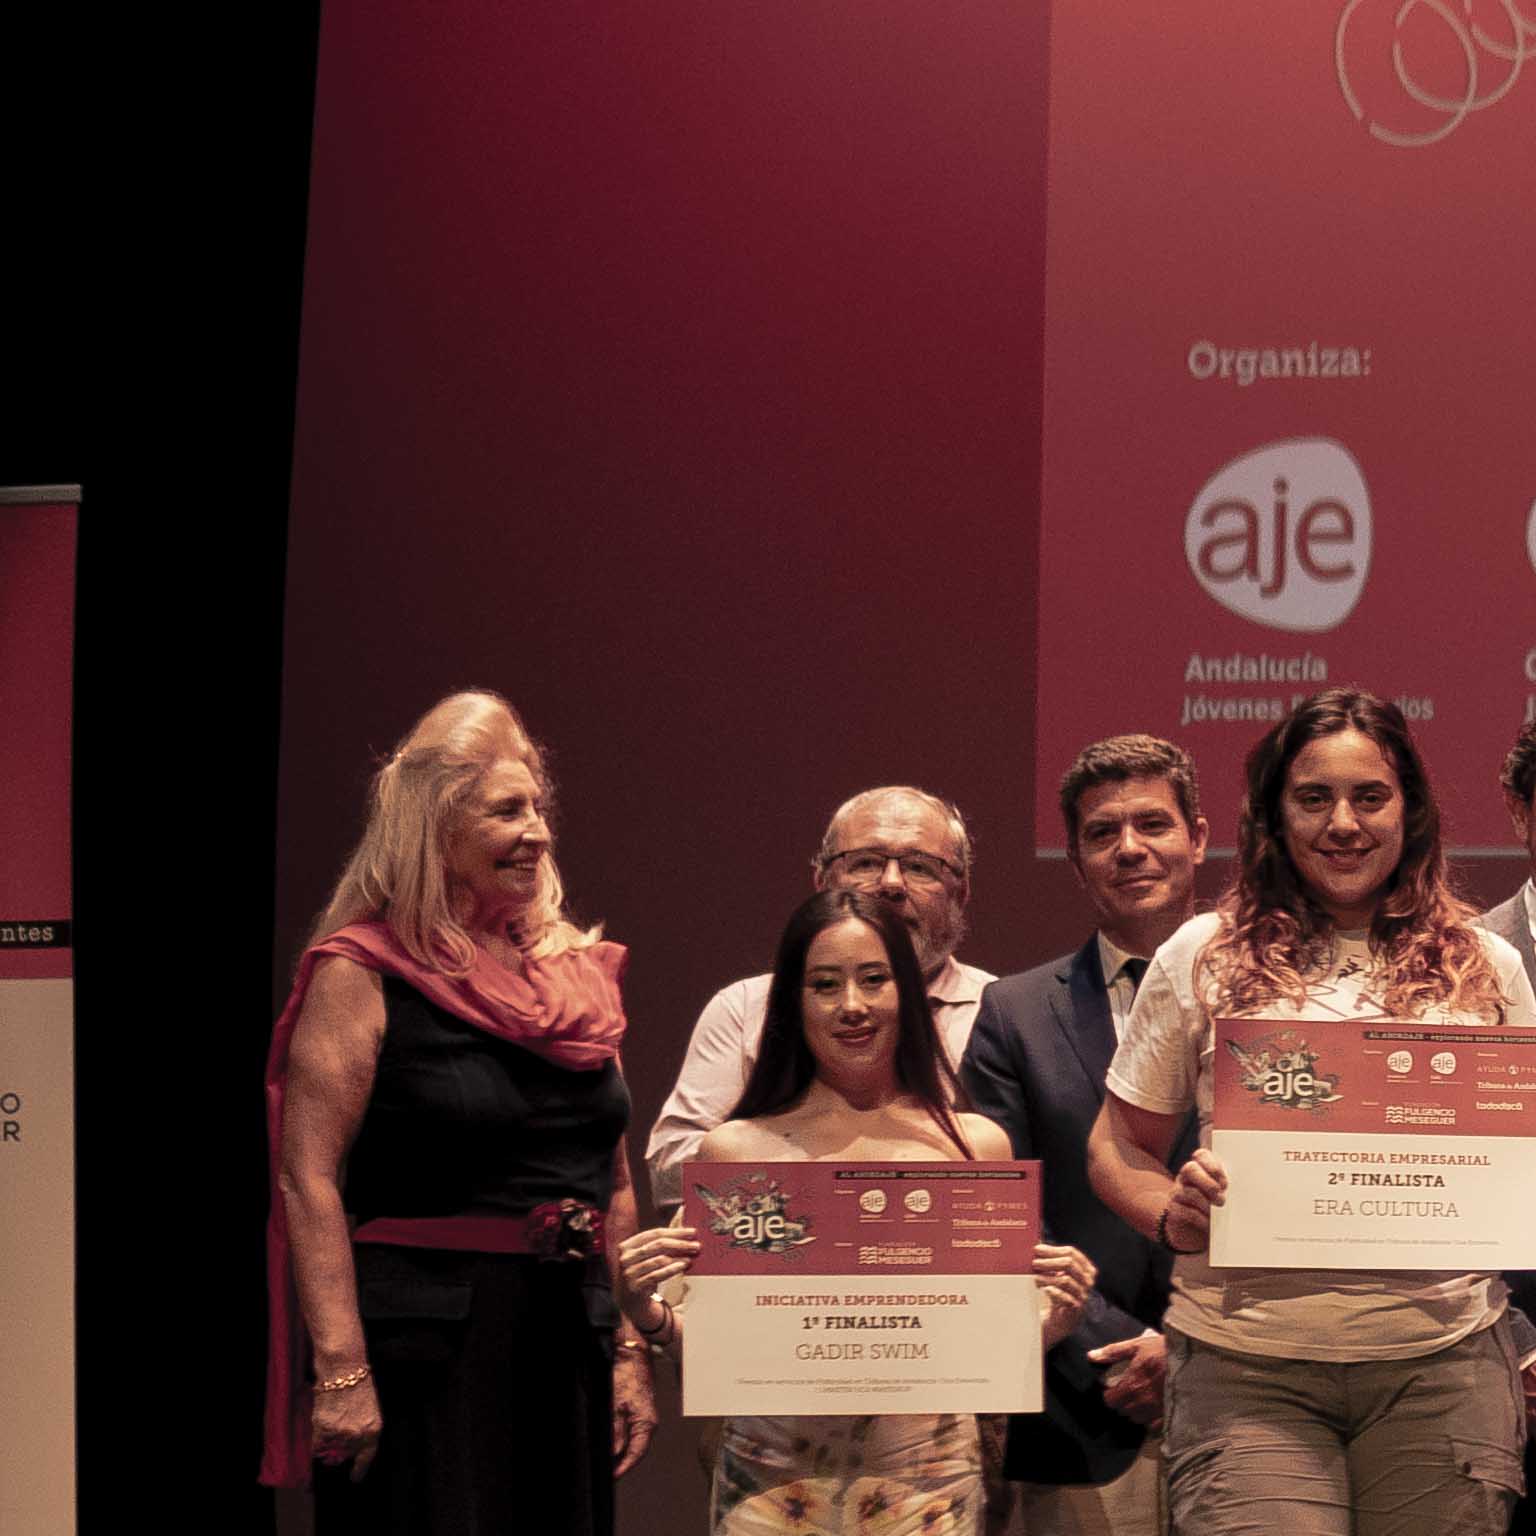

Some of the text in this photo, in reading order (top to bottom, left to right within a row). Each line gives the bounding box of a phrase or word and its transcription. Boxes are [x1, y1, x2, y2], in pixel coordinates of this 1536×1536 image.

[1186, 341, 1372, 384] Organiza:
[1199, 475, 1356, 596] aje
[1184, 651, 1329, 684] Andalucía
[1181, 693, 1285, 727] Jóvenes
[1263, 1071, 1315, 1100] aje
[1283, 1151, 1491, 1166] TRAYECTORIA EMPRESARIAL
[1350, 1173, 1446, 1188] FINALISTA
[1312, 1199, 1460, 1218] ERA CULTURA
[733, 1212, 787, 1243] aje
[755, 1294, 969, 1307] INICIATIVA EMPRENDEDORA
[824, 1316, 923, 1330] FINALISTA
[795, 1343, 930, 1361] GADIR SWIM
